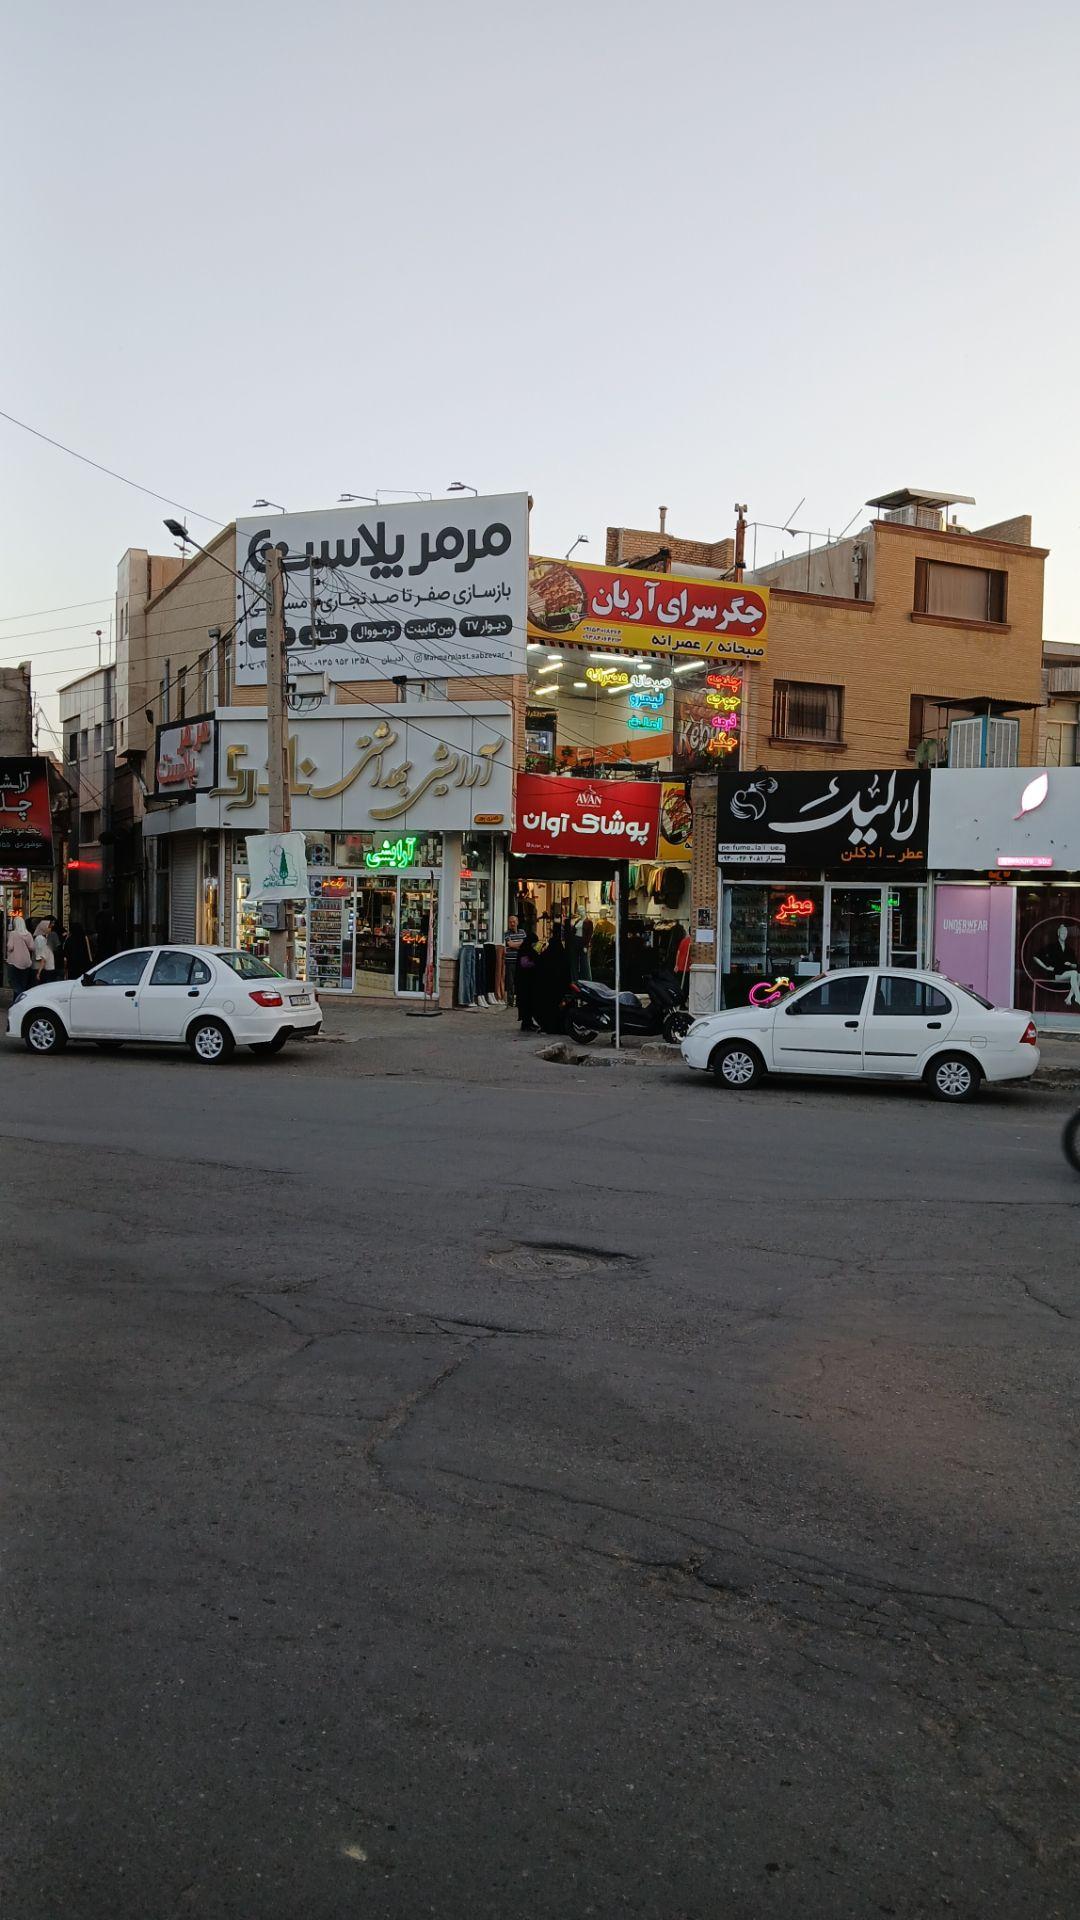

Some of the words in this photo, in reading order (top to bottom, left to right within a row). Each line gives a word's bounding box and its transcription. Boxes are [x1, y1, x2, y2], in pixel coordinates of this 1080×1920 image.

[408, 522, 512, 576] مرمر
[320, 592, 367, 613] تجاری
[370, 592, 399, 604] صد
[402, 588, 412, 602] تا
[414, 586, 450, 607] صفر
[453, 581, 511, 605] بازسازی
[591, 580, 660, 619] آریان
[657, 589, 717, 626] سرای
[715, 596, 763, 632] جگر
[406, 622, 436, 636] کابینت
[437, 624, 454, 636] بین
[466, 621, 479, 630] TV
[480, 621, 506, 634] دیوار
[651, 635, 700, 651] عصرانه
[718, 642, 764, 658] صبحانه
[586, 667, 628, 687] عصرانه
[630, 674, 672, 692] صبحانه
[707, 694, 741, 710] جوجه
[367, 735, 504, 820] آرایشی
[576, 793, 603, 804] AVAN
[768, 770, 920, 845] لالیک
[523, 812, 570, 838] آوان
[572, 809, 650, 846] پوشاک
[365, 837, 416, 869] آرایشی
[841, 846, 883, 863] ادکلن
[898, 850, 924, 863] عطر
[775, 894, 814, 921] عطر
[943, 919, 988, 932] UNDERWEAR
